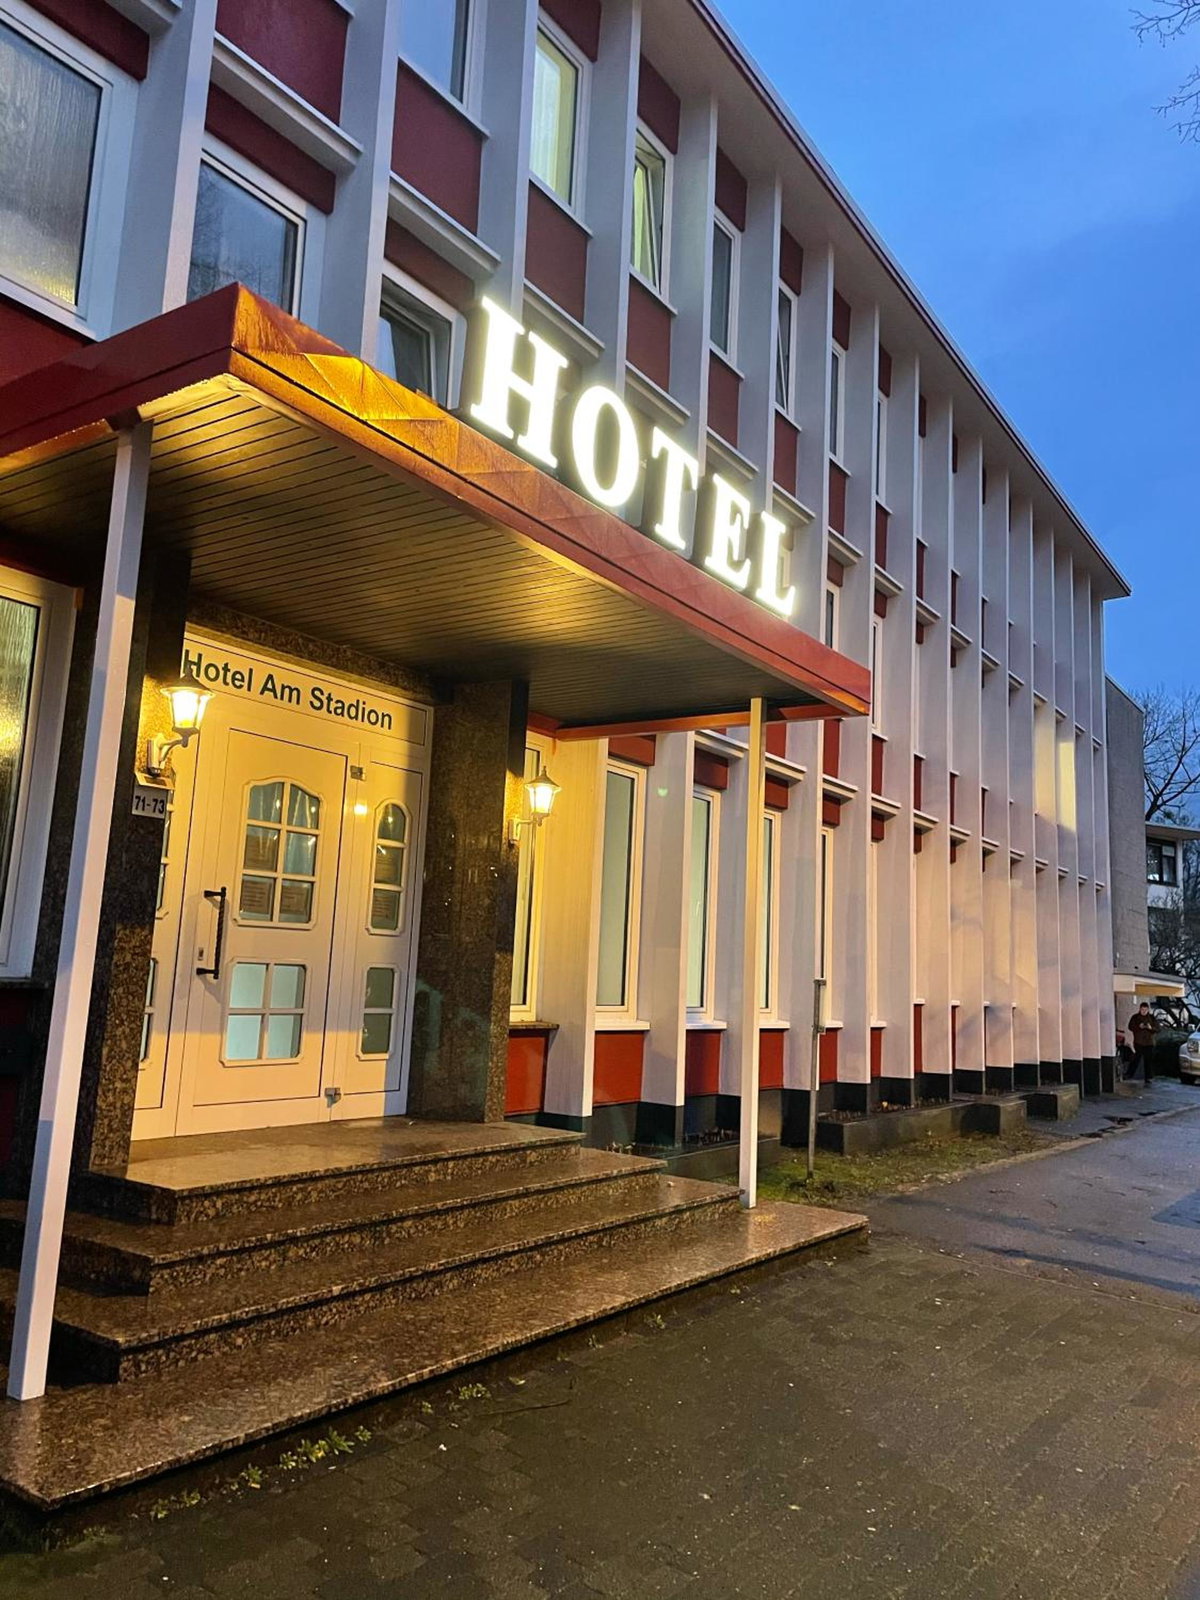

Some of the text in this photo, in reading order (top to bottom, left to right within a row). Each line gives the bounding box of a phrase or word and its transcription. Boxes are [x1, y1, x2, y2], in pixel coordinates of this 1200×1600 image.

[470, 295, 796, 617] HOTEL
[183, 648, 393, 730] Hotel Am Stadion
[135, 795, 165, 814] 71-73
